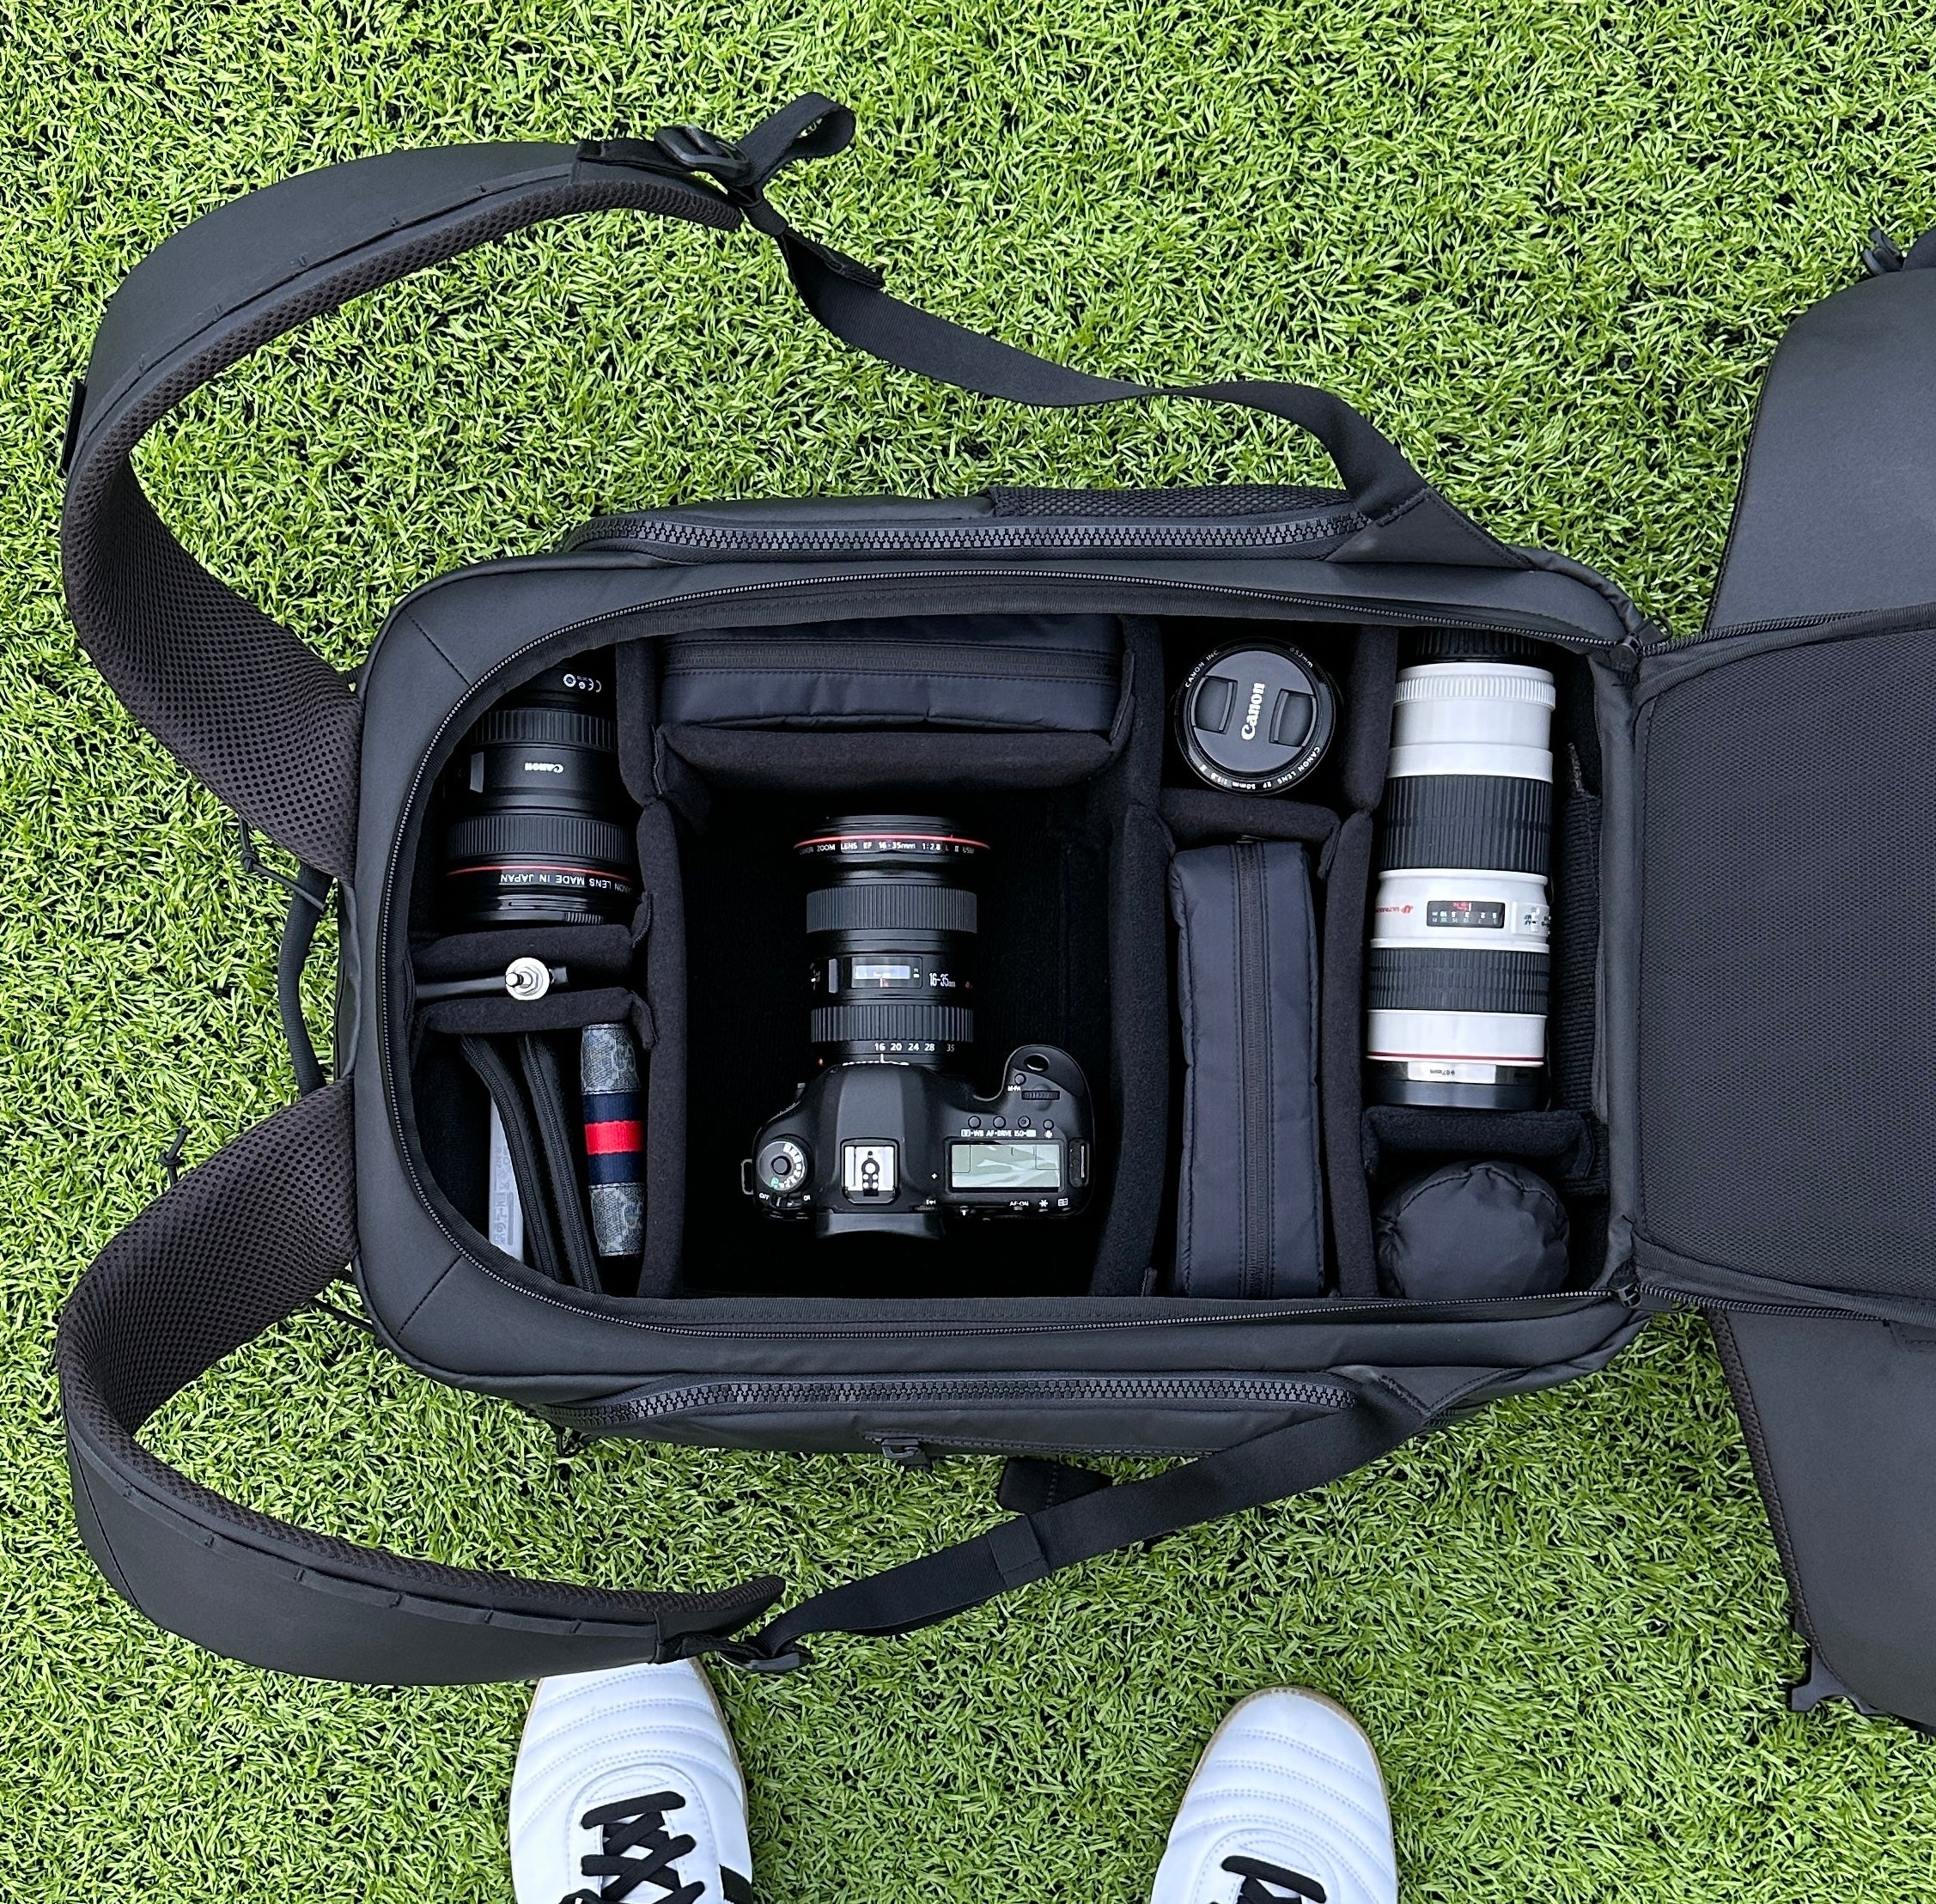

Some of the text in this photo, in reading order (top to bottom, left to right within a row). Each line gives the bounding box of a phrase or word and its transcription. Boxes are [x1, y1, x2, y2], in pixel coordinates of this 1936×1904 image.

[1185, 661, 1205, 688] CANON
[1241, 683, 1265, 740] Canon
[1298, 746, 1321, 772] CANON
[1277, 770, 1297, 785] LENS
[816, 843, 836, 853] ZOOM
[841, 842, 858, 850] LENS
[500, 873, 534, 883] JAPAN
[539, 873, 551, 883] IN
[556, 874, 585, 885] MADE
[589, 878, 611, 890] LENS
[874, 1042, 955, 1052] 16 20 24 28 35
